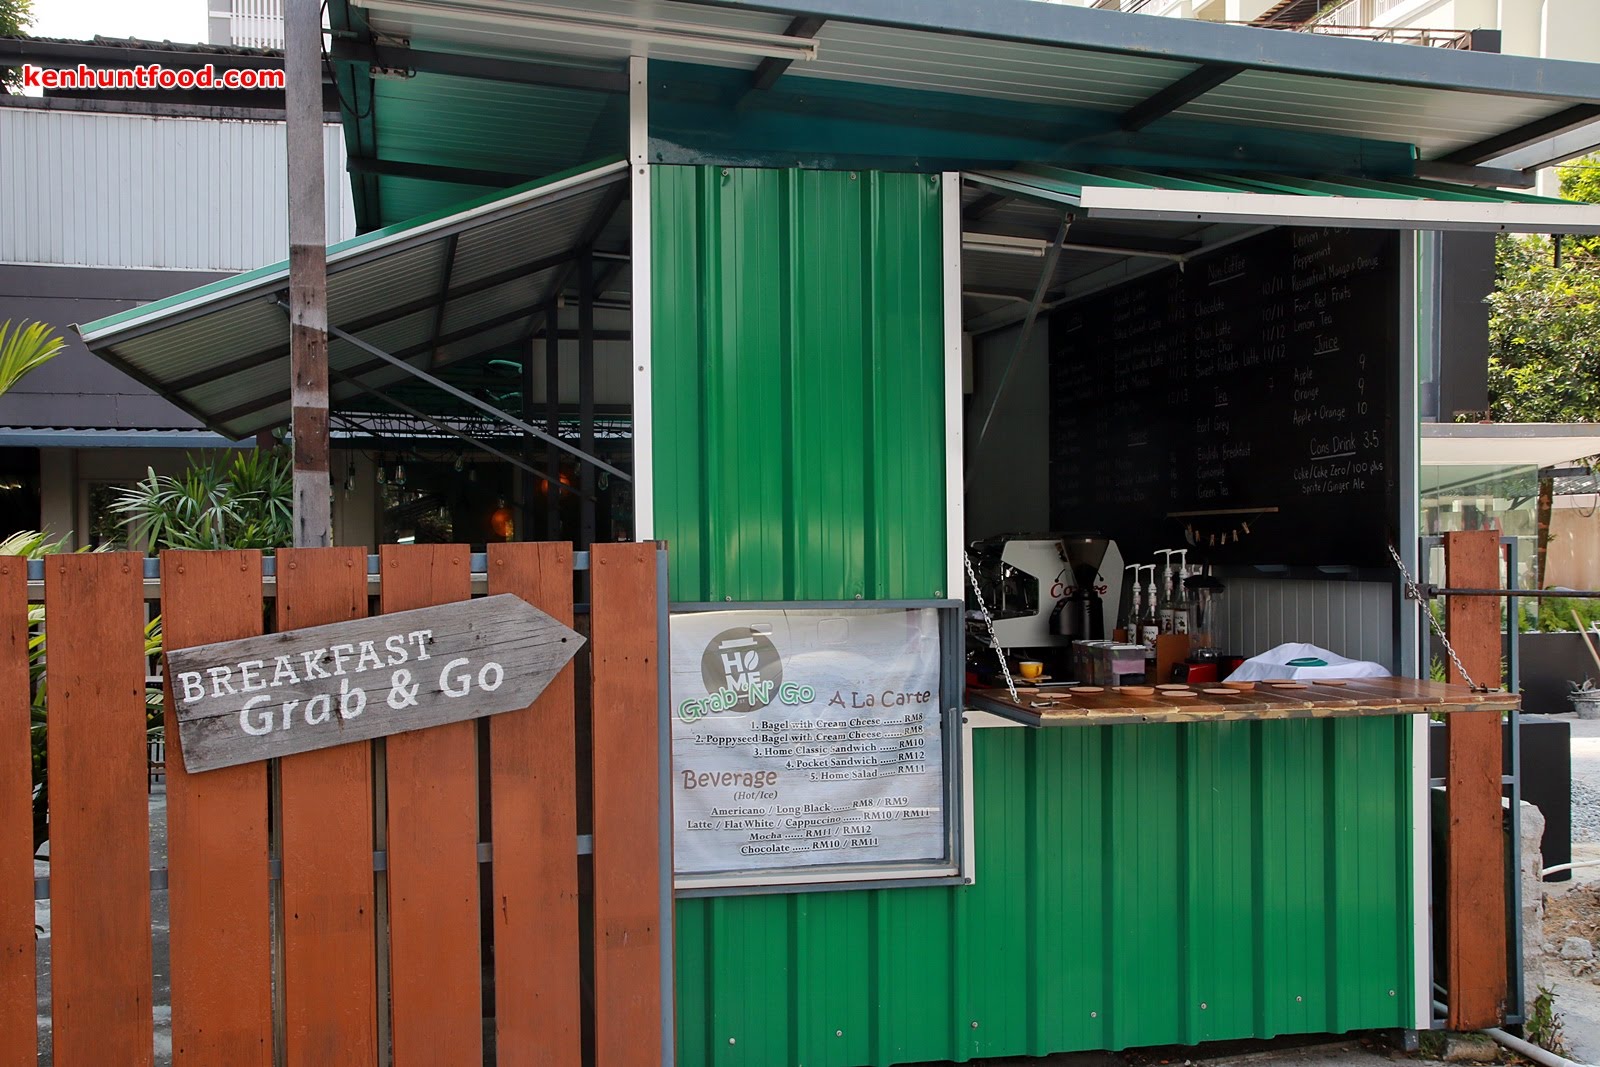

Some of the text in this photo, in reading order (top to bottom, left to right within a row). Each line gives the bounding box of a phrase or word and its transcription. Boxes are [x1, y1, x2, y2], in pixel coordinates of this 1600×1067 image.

[1331, 285, 1352, 302] Fruits
[1318, 311, 1332, 325] Tea
[1314, 334, 1338, 353] Juice
[1294, 365, 1313, 386] Apple
[1359, 353, 1365, 370] 9
[1294, 377, 1365, 402] Orange 9
[1292, 408, 1312, 426] Apple
[1320, 404, 1346, 421] Orange
[1357, 401, 1368, 415] 10
[1332, 431, 1356, 453] Drink
[1352, 462, 1368, 473] 100
[1353, 477, 1365, 489] Ale
[177, 630, 435, 703] BREAKFAST
[239, 657, 505, 736] Grab & Go
[678, 686, 738, 723] Grab
[779, 681, 815, 705] Go
[828, 689, 931, 709] A La Carte
[751, 713, 923, 731] 1. Bagel with Cream Cheese RM8
[706, 734, 758, 747] Poppyseed
[761, 733, 788, 745] Bagel
[791, 732, 813, 742] with
[816, 732, 846, 741] Cream
[848, 730, 882, 739] Cheese
[904, 725, 923, 735] RM8
[754, 738, 924, 756] 3. Home Classic Sandwich RM10
[785, 751, 925, 769] 4. Pocket Sandwich RM12
[681, 769, 778, 789] Beverage
[810, 764, 925, 780] 5. Home Salad RM11
[733, 790, 778, 801] (Hot/Ice)
[711, 806, 766, 816] Americano
[776, 804, 801, 816] Long
[803, 803, 831, 813] Black
[852, 799, 874, 808] RM8
[885, 797, 908, 806] RM9
[687, 820, 713, 829] Latte
[724, 820, 743, 829] Flat
[744, 819, 774, 828] White
[785, 816, 841, 828] Cappuccino
[863, 811, 892, 821] RM10
[903, 809, 930, 818] RM11
[749, 832, 782, 841] Mocha
[805, 828, 832, 838] RM11
[843, 825, 872, 835] RM12
[741, 843, 790, 855] Chocolate
[812, 839, 840, 849] RM10
[851, 837, 879, 847] RM11
